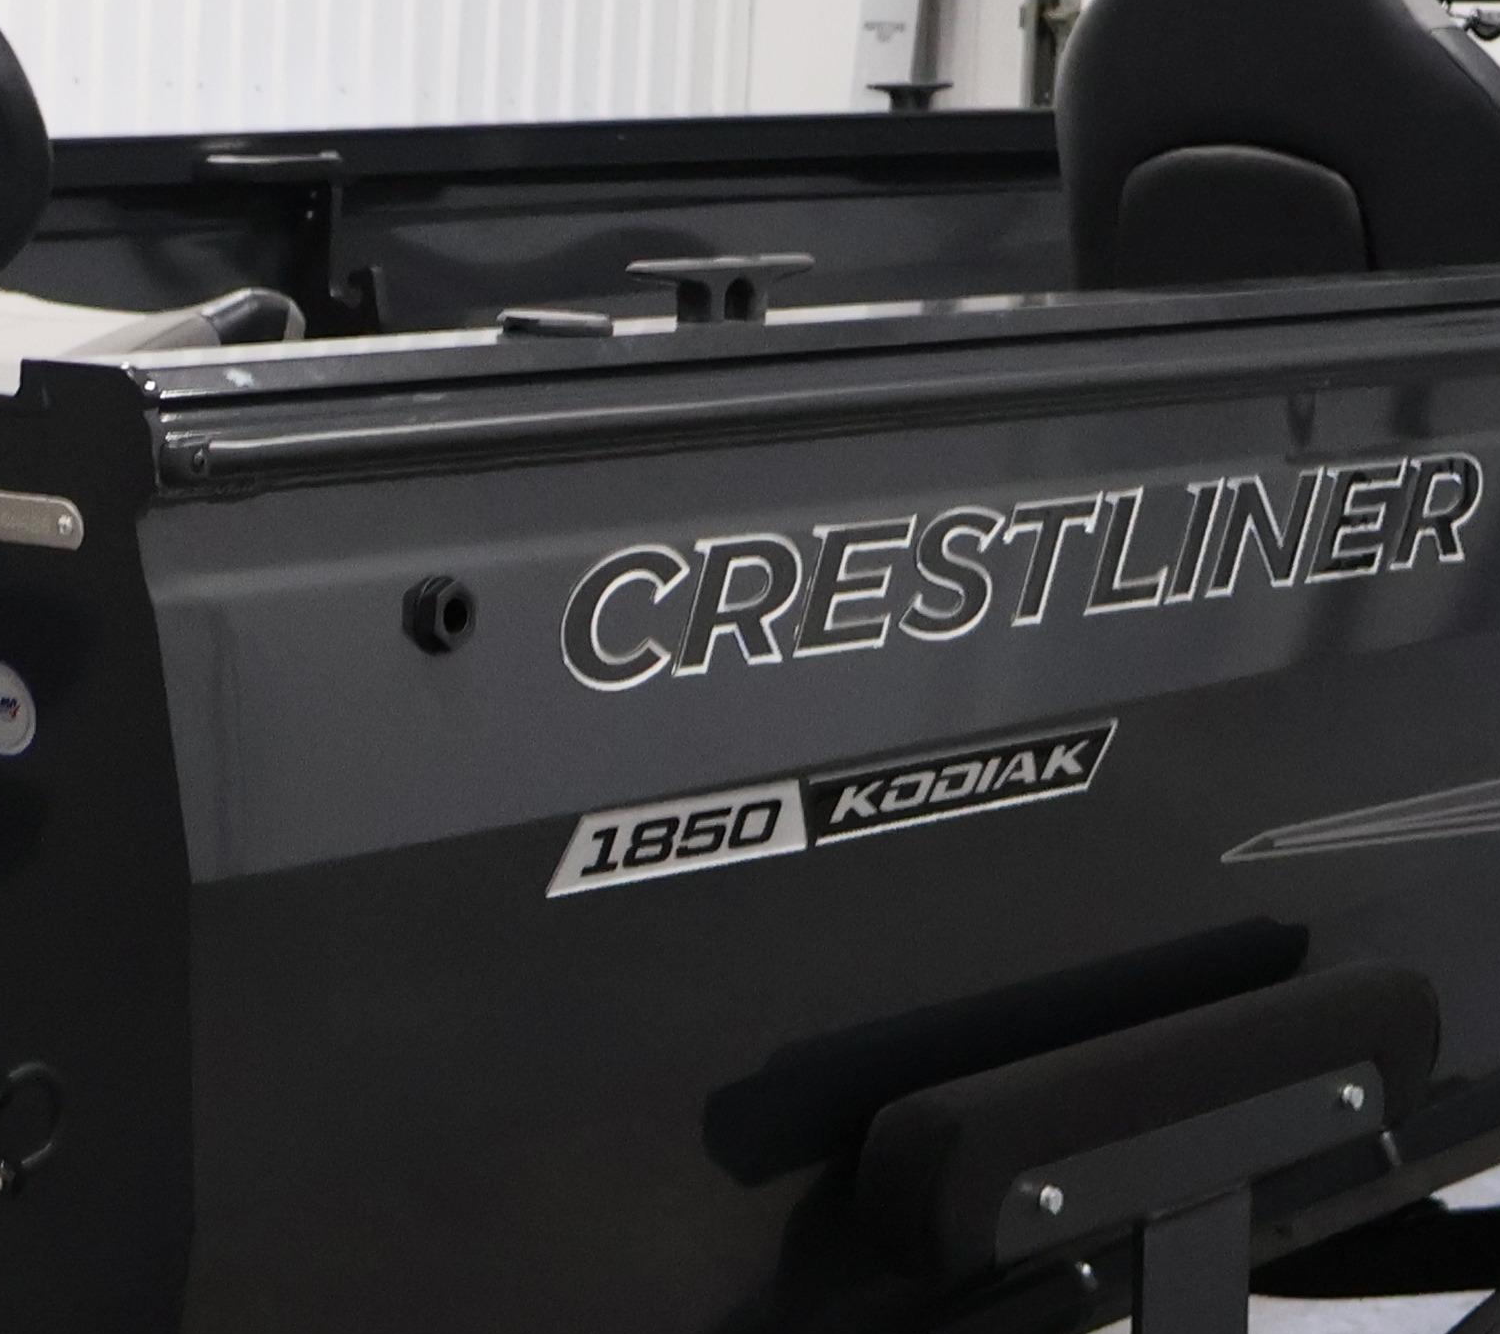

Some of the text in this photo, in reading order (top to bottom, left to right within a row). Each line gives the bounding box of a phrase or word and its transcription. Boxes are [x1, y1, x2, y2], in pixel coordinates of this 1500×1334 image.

[560, 454, 1483, 692] CRESTLINER
[580, 738, 1091, 877] 1850 KODIAK
